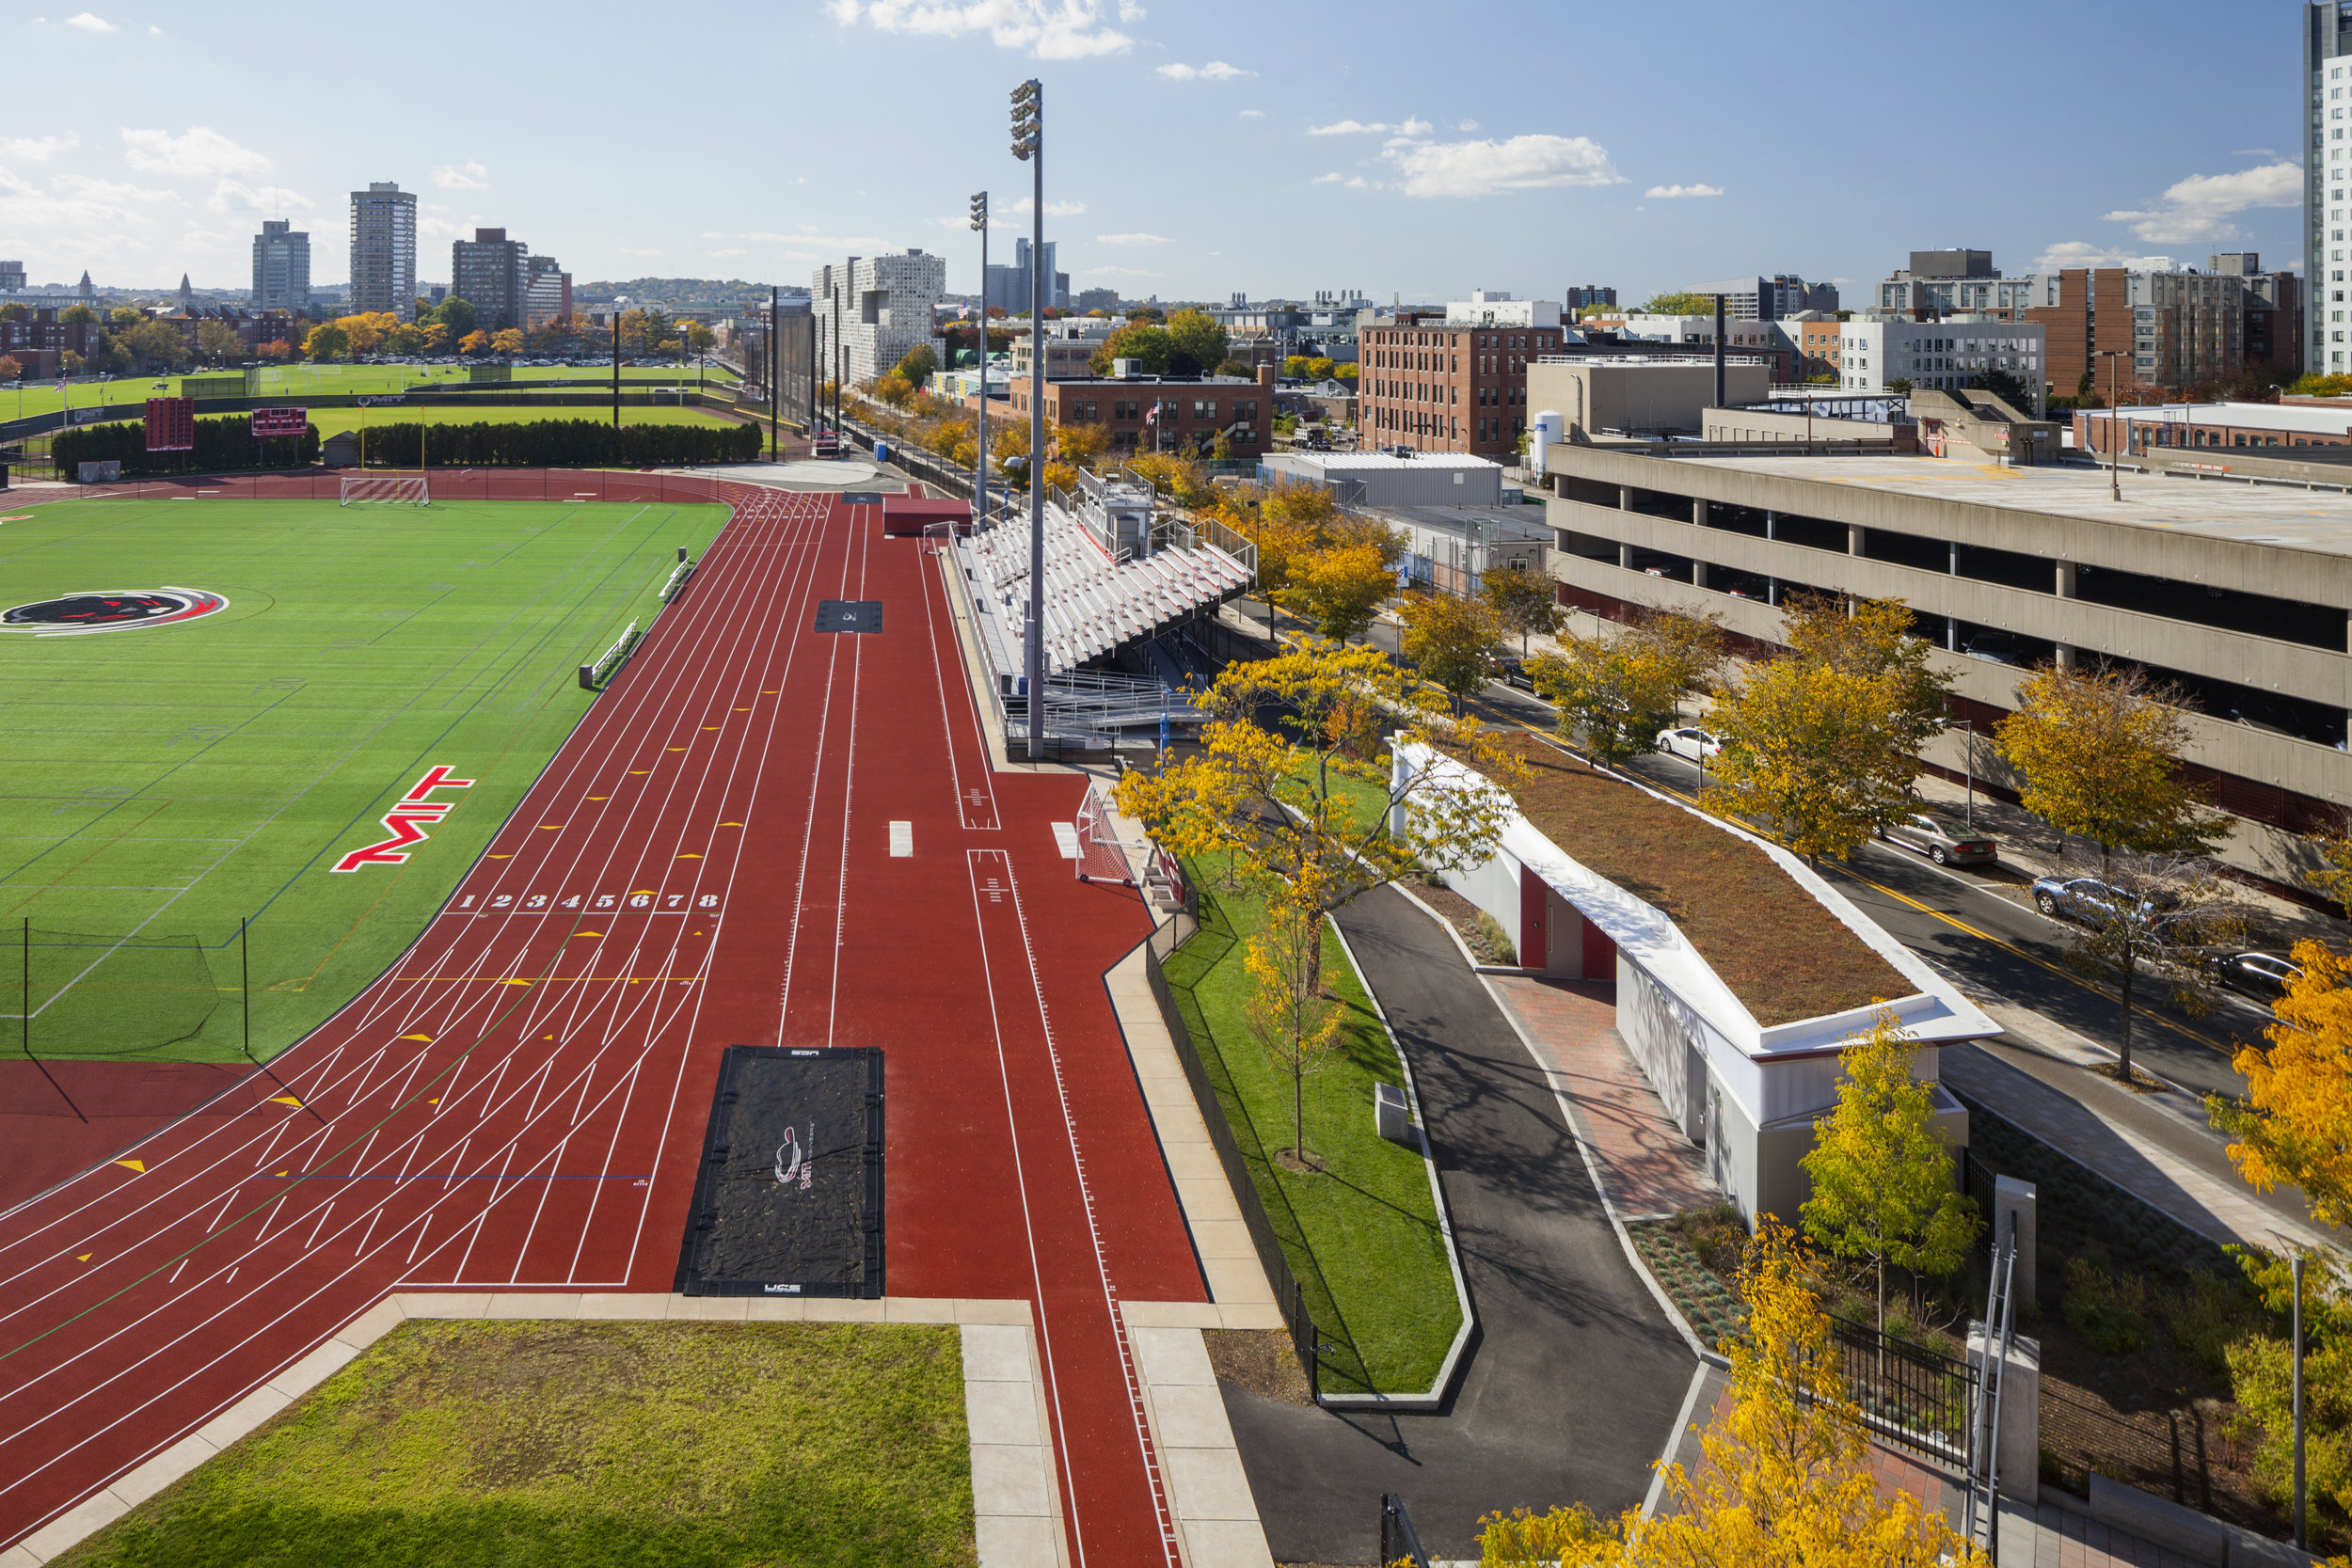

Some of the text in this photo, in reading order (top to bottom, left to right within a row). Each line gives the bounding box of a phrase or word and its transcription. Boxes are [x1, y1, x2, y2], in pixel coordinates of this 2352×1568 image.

[329, 765, 476, 873] MIT
[459, 895, 718, 908] 1 2 3 4 5 6 7 8
[801, 1161, 812, 1190] MIT
